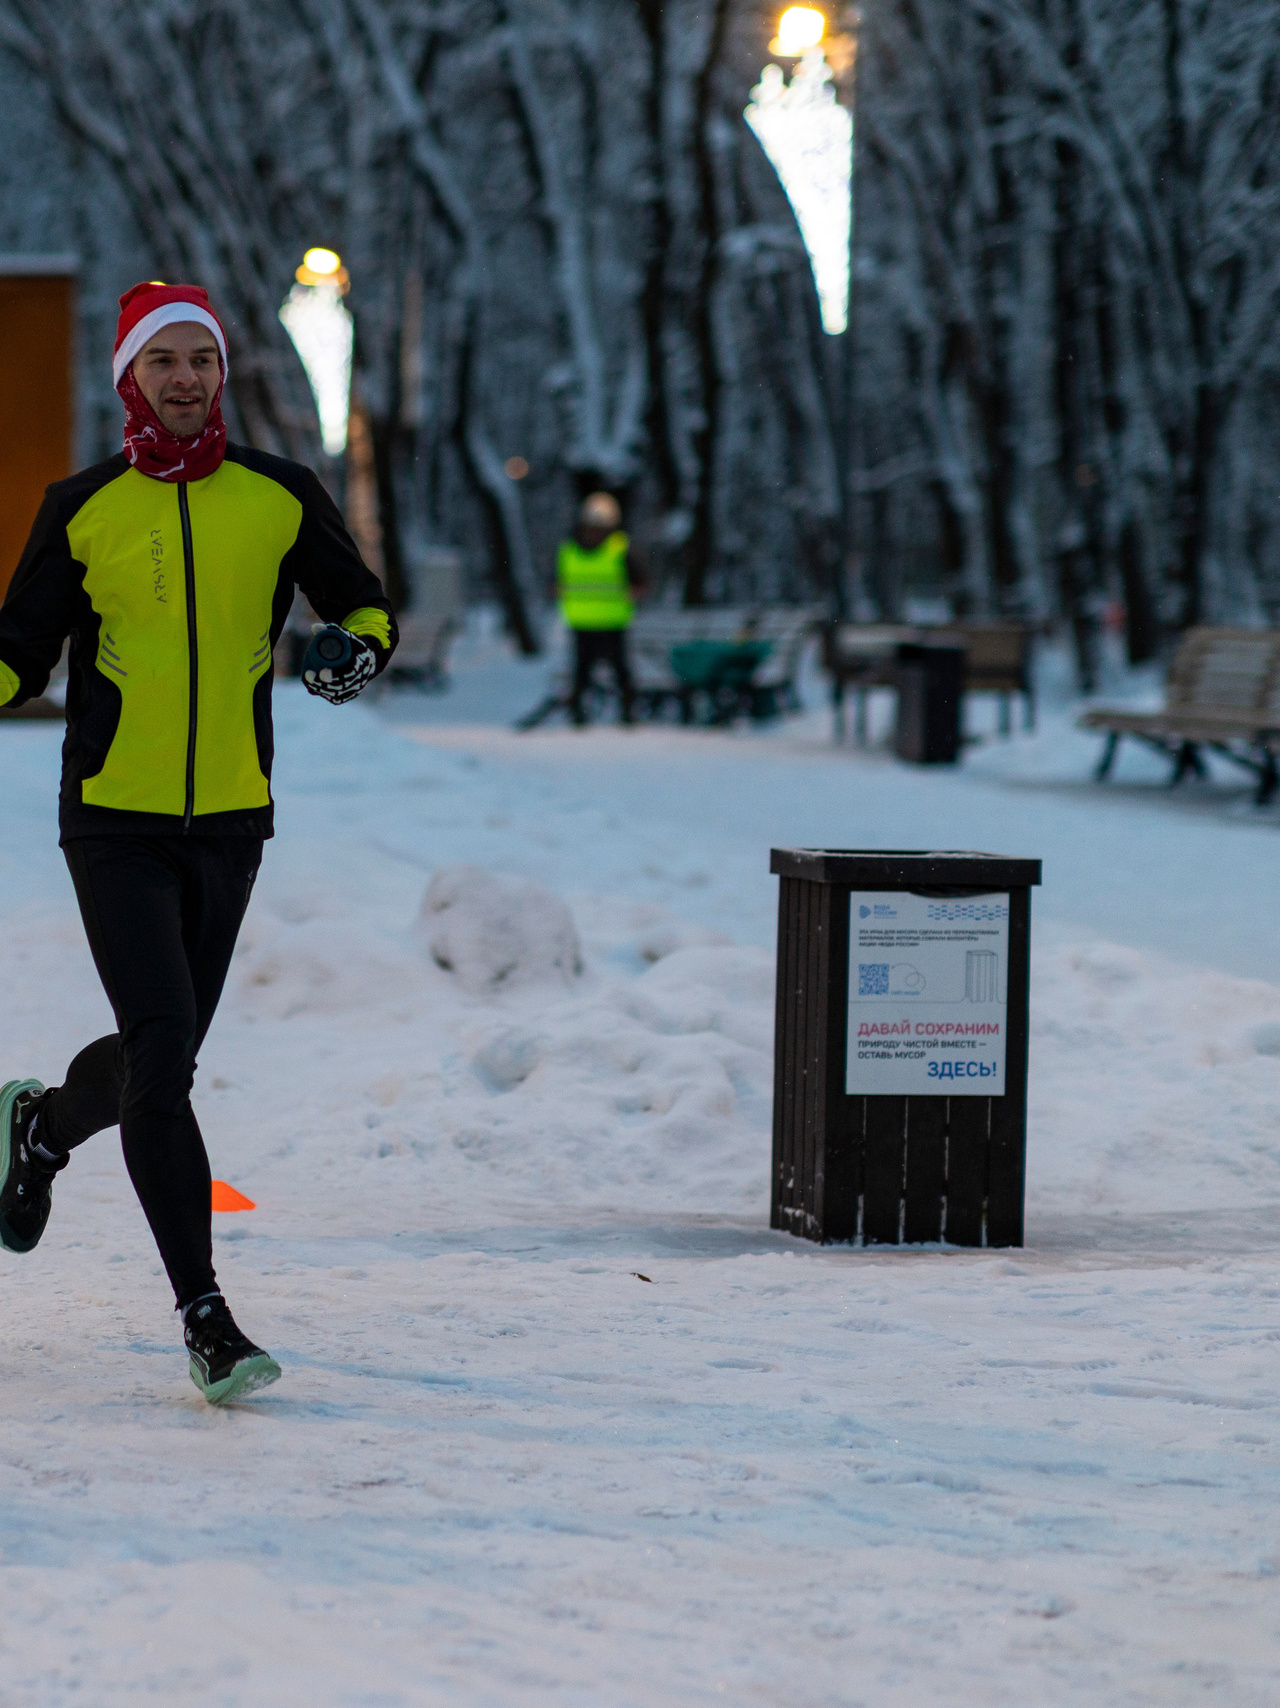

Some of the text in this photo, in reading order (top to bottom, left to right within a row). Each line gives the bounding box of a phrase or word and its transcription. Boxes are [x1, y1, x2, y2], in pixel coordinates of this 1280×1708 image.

[857, 1018, 1000, 1037] ДАВАЙ СОХРАНИМ
[858, 1040, 900, 1049] ПРИРОДУ
[903, 1038, 939, 1049] ЧИСТОЙ
[941, 1040, 977, 1048] ВМЕСТЕ
[858, 1051, 926, 1060] ОСТАВЬ МУСОР
[927, 1061, 997, 1080] ЗДЕСЬ!
